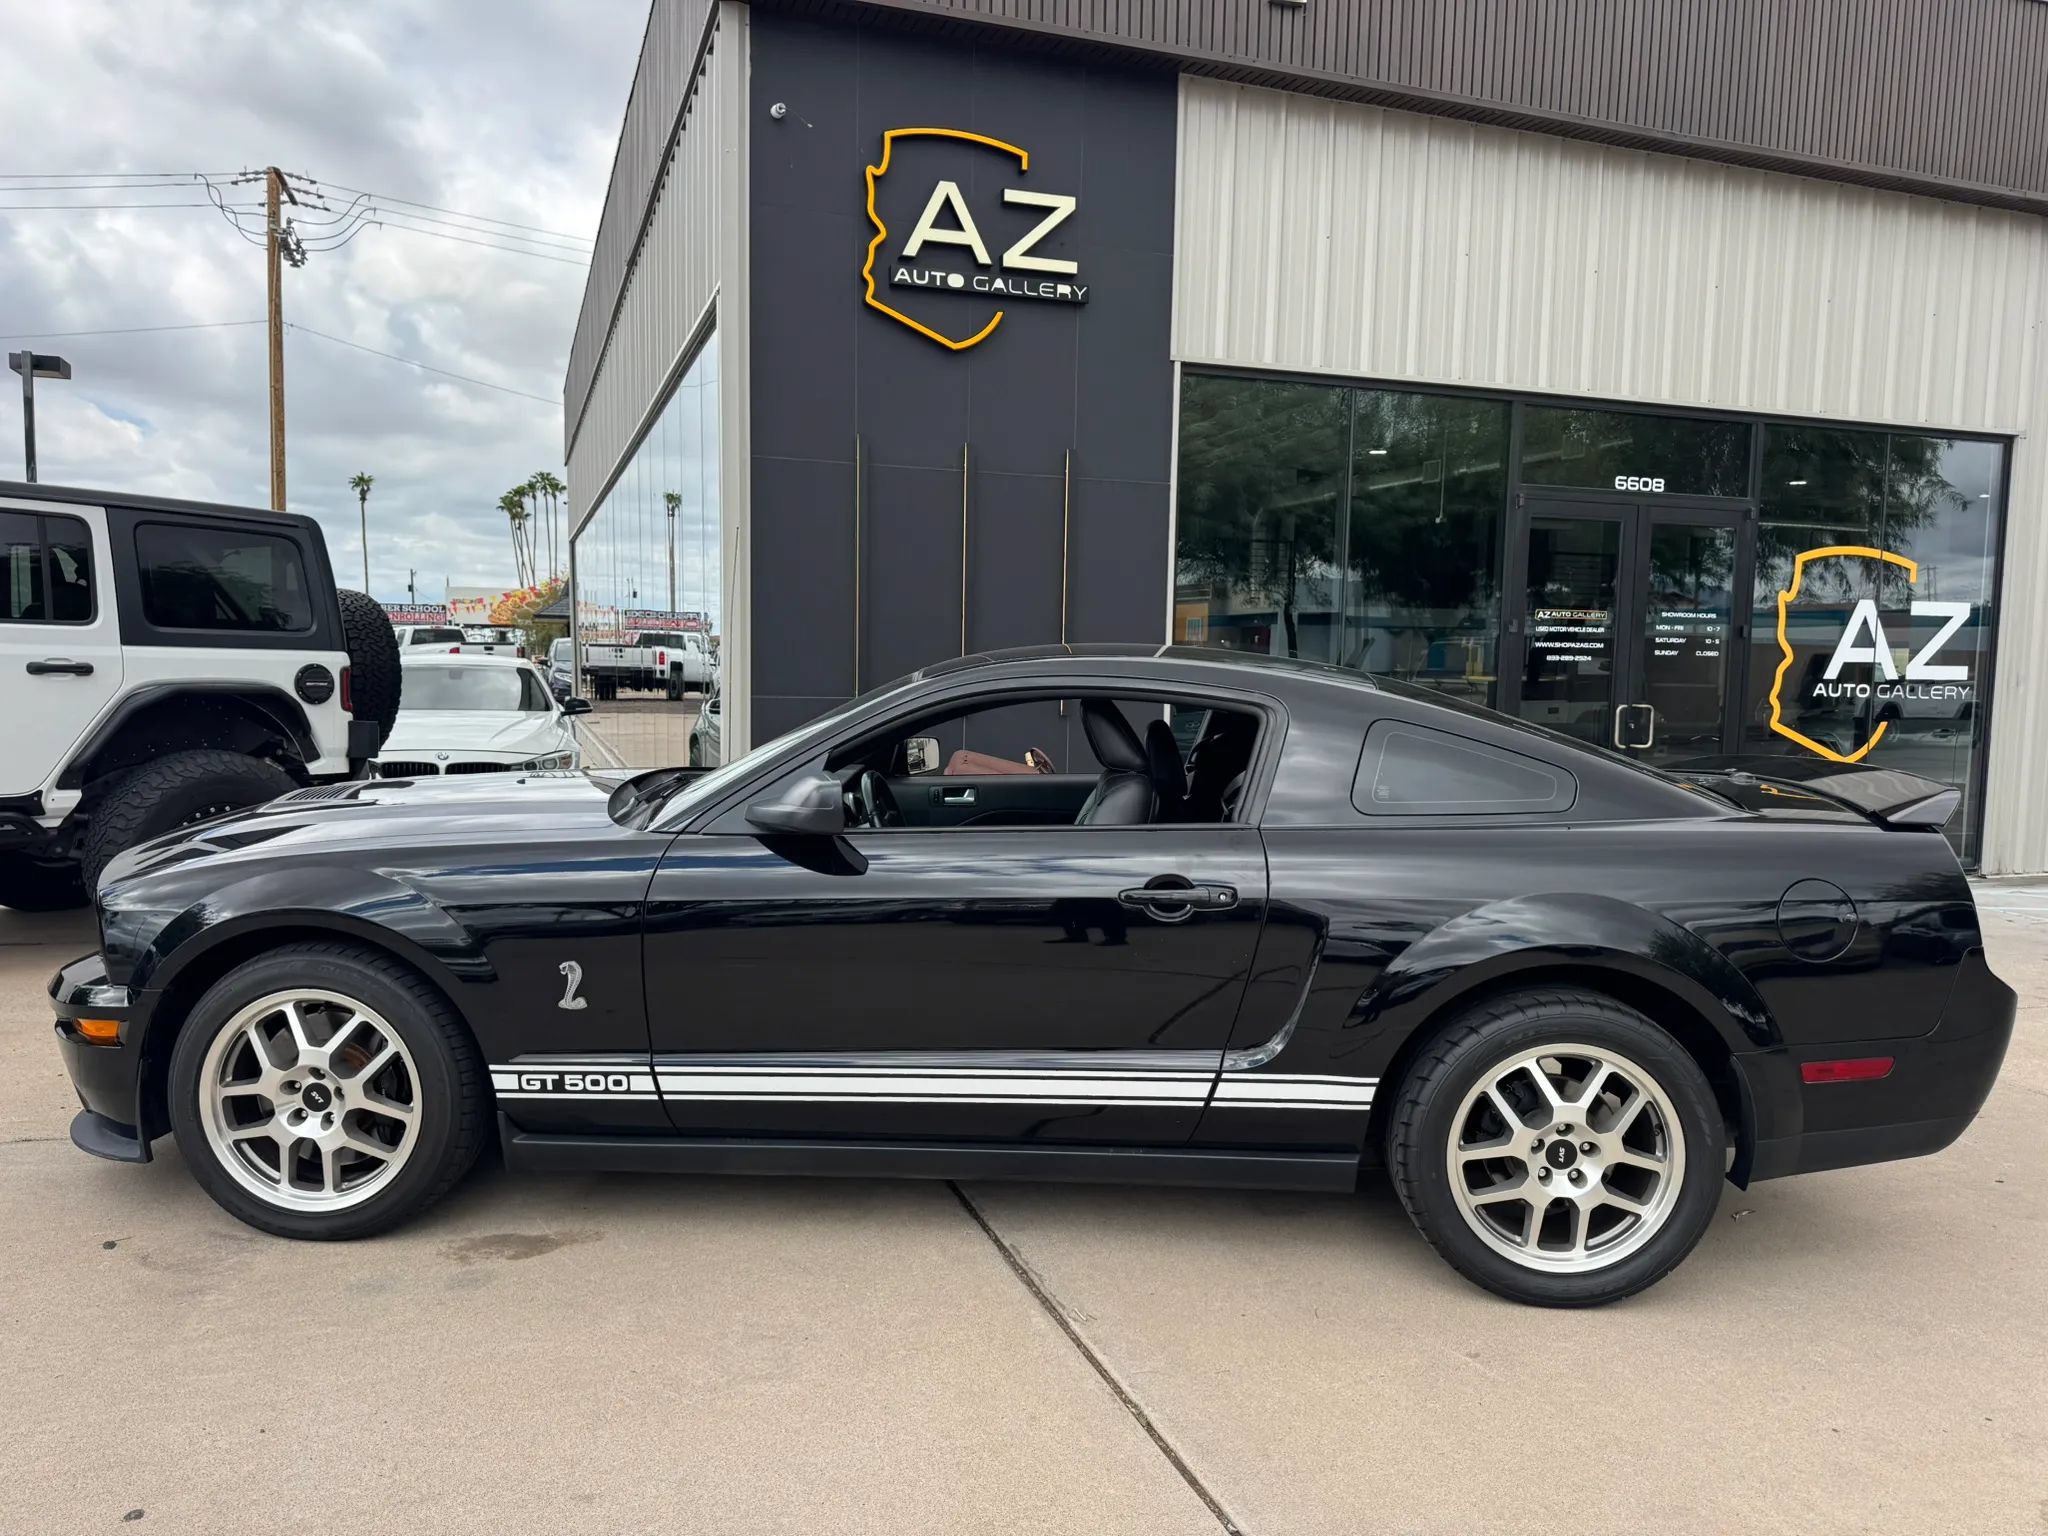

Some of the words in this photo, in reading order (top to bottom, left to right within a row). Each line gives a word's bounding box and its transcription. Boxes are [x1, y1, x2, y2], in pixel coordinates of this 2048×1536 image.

[902, 180, 1078, 274] AZ
[894, 268, 964, 287] AUTO
[973, 275, 1088, 300] GALLERY
[1615, 476, 1665, 492] 6608
[402, 605, 445, 613] SCHOOL
[1823, 599, 1971, 680] AZ
[1813, 683, 1871, 698] AUTO
[1876, 685, 1971, 700] GALLERY
[520, 1074, 559, 1090] GT
[564, 1074, 628, 1091] 500
[310, 1091, 324, 1103] SVT
